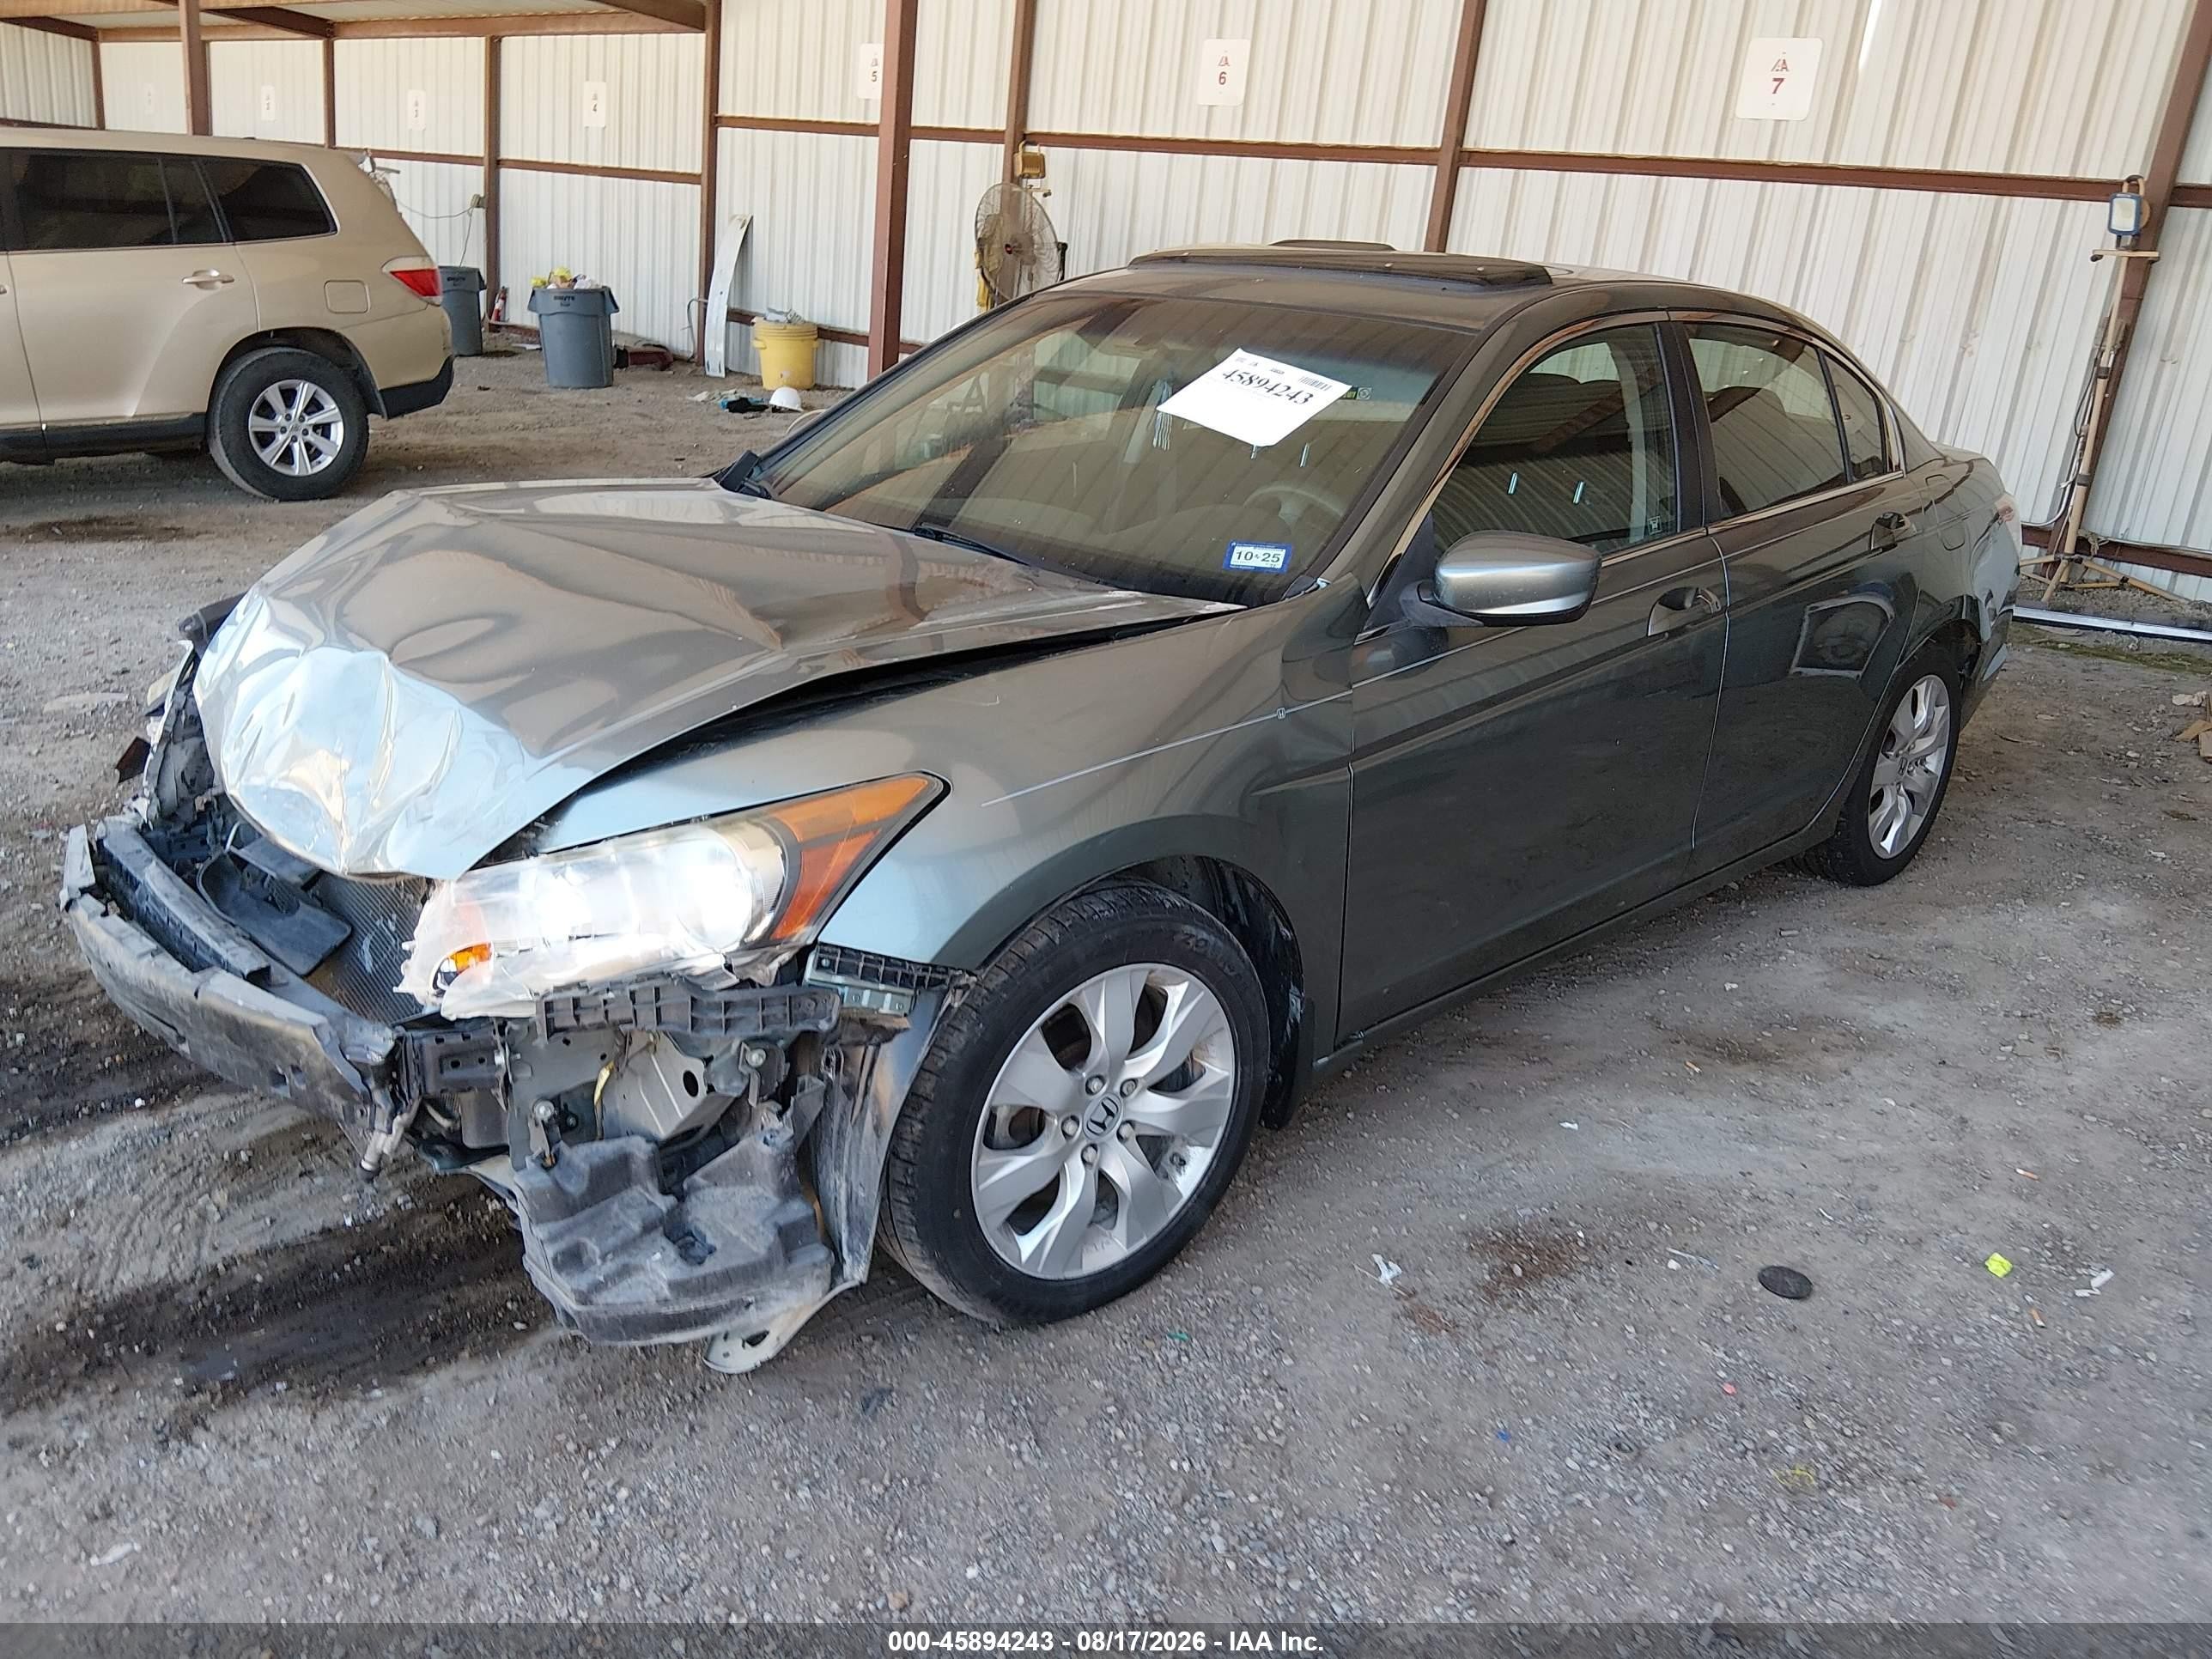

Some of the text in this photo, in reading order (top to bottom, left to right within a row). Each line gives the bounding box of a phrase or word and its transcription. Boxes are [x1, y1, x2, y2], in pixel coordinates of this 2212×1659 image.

[871, 70, 878, 82] 5
[1218, 71, 1227, 85] 6
[1771, 77, 1786, 94] 7
[1223, 368, 1314, 405] 45894243
[1236, 550, 1281, 563] 10 25
